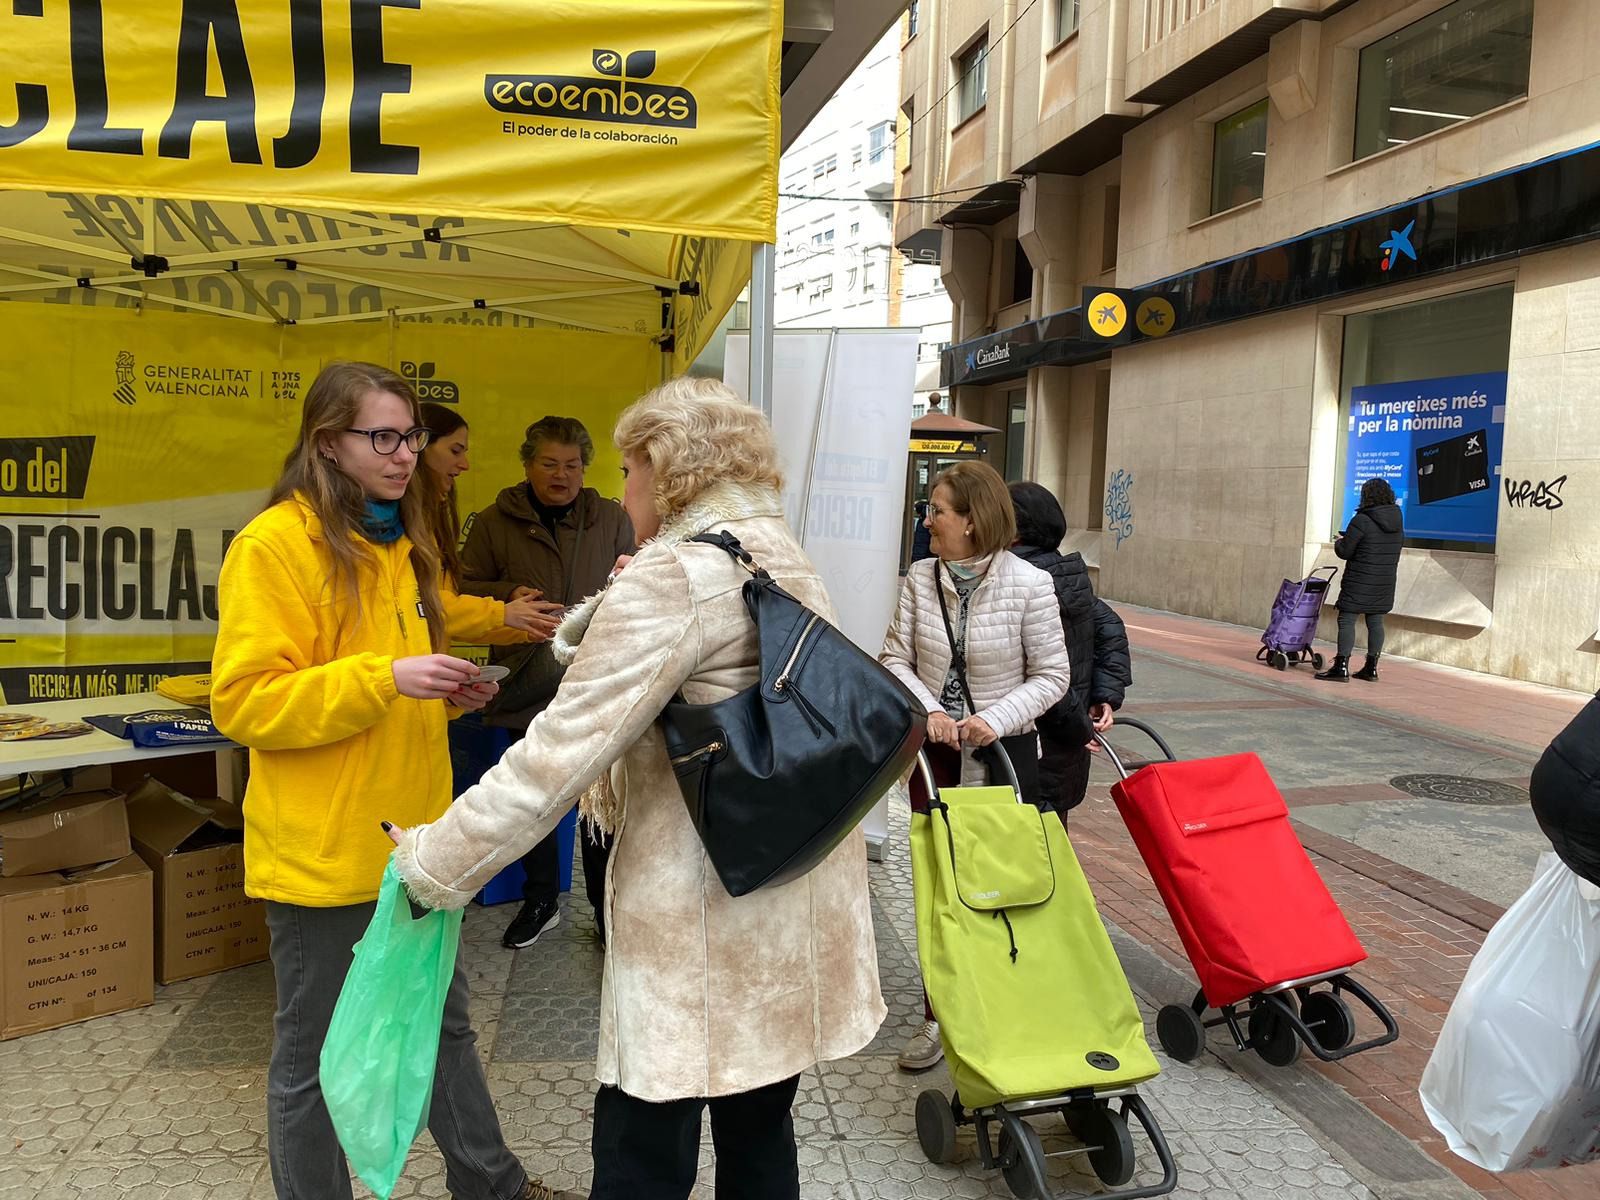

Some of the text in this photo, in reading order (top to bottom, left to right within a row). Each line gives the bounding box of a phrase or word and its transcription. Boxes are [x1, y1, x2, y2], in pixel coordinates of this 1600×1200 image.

[492, 80, 690, 121] ecoembes
[502, 121, 678, 145] El poder de la colaboración
[976, 342, 1010, 365] CaixaBank
[143, 365, 252, 382] GENERALITAT
[145, 381, 249, 398] VALENCIANA
[409, 379, 455, 399] bes
[1360, 390, 1487, 417] Tu mereixes més
[1358, 412, 1463, 437] per la nòmina
[26, 447, 67, 493] del
[1468, 478, 1486, 489] VISA
[28, 674, 82, 699] RECICLA
[179, 722, 209, 732] PAPER
[62, 907, 73, 915] 14
[75, 904, 90, 913] KG
[211, 905, 220, 913] 34
[62, 927, 81, 937] 14,7
[83, 924, 98, 933] KG
[27, 955, 56, 967] Meas:
[59, 951, 70, 960] 34
[79, 948, 89, 956] 51
[99, 944, 110, 952] 36
[112, 941, 127, 950] CM
[185, 949, 203, 959] CTN
[28, 968, 97, 989] UNI/CAJA: 150
[28, 1000, 49, 1011] CTN
[87, 990, 97, 998] of
[102, 985, 117, 995] 134
